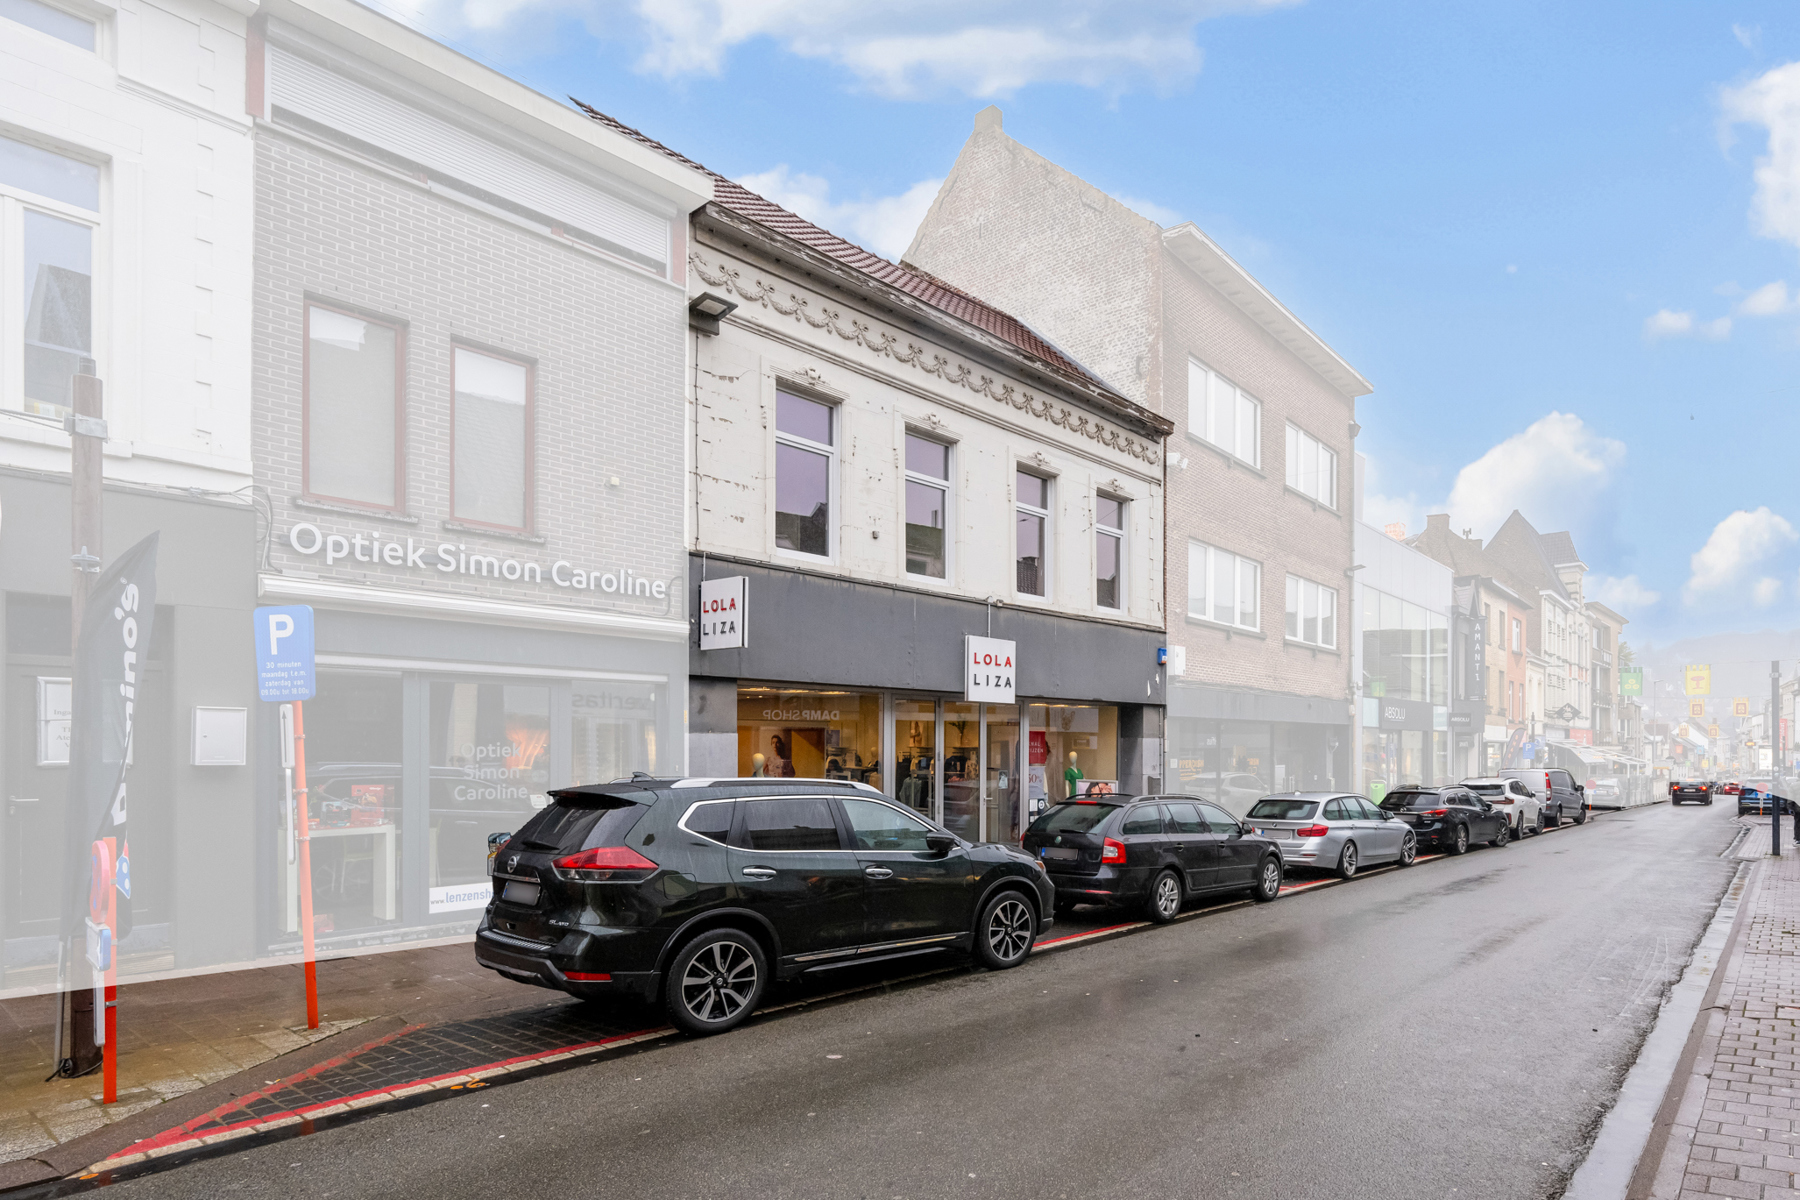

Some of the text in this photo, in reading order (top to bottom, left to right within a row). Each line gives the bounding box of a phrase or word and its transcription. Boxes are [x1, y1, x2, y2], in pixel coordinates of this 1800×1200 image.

[289, 522, 667, 600] Optiek Simon Caroline
[703, 598, 736, 613] LOLA
[269, 614, 294, 655] P
[703, 620, 736, 636] LIZA
[974, 652, 1012, 667] LOLA
[974, 673, 1012, 688] LIZA
[1384, 706, 1406, 719] ABSOLU
[460, 741, 522, 761] Optiek
[1525, 743, 1532, 751] P
[463, 764, 520, 779] Simon
[454, 783, 528, 801] Caroline
